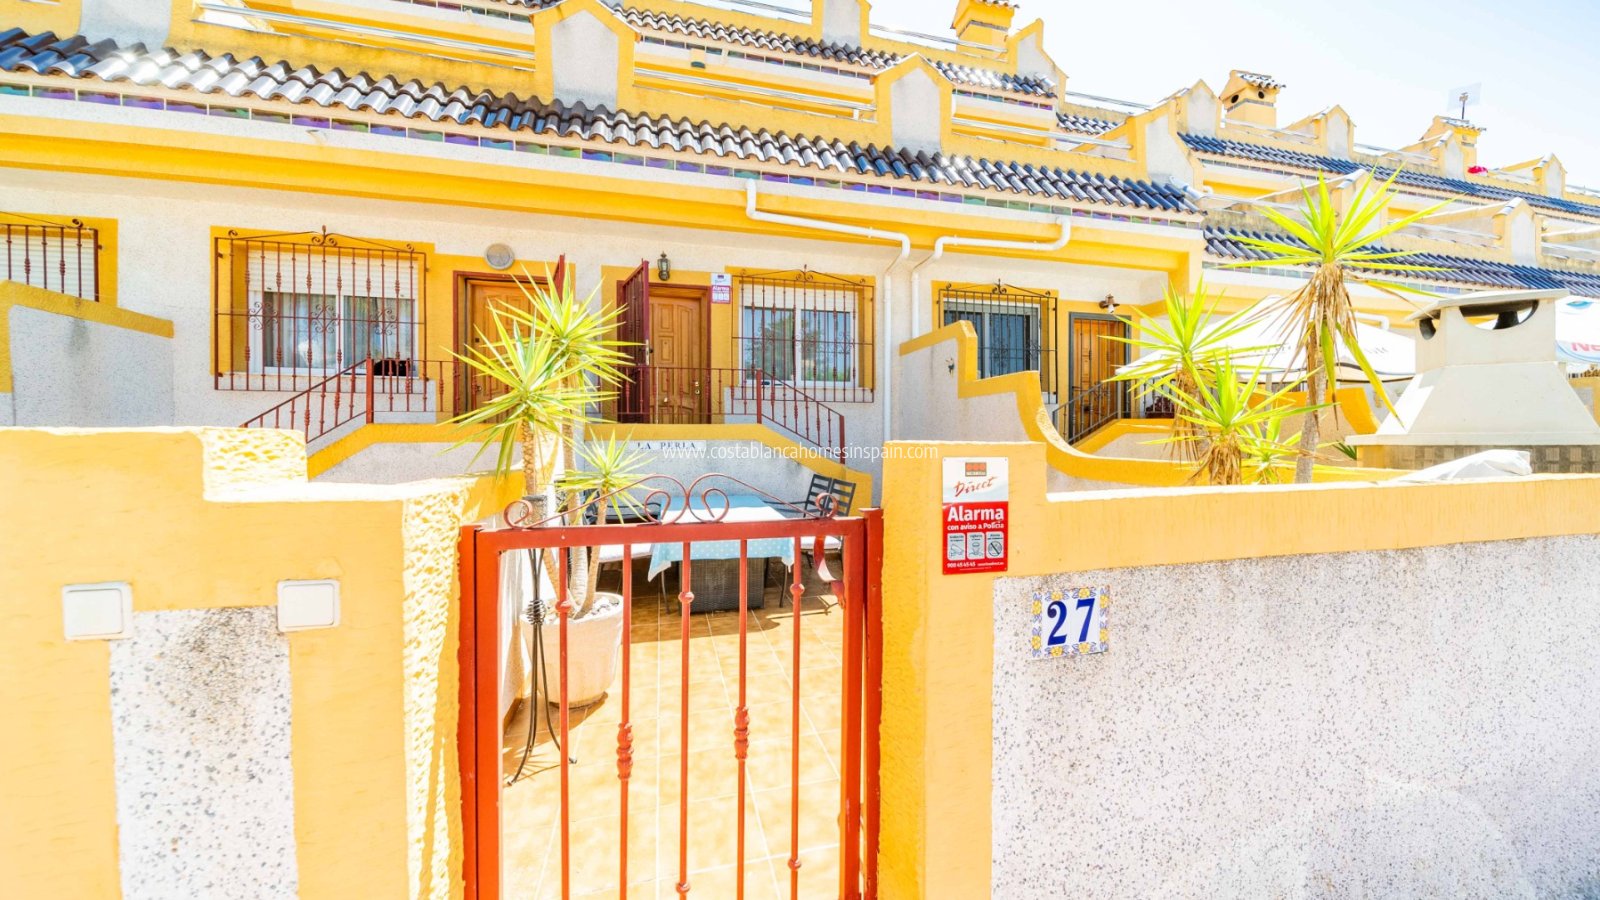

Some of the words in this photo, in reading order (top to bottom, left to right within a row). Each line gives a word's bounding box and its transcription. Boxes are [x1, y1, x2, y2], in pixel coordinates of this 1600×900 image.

[953, 476, 998, 497] Direct
[947, 505, 1004, 522] Alarma
[1047, 597, 1095, 646] 27
